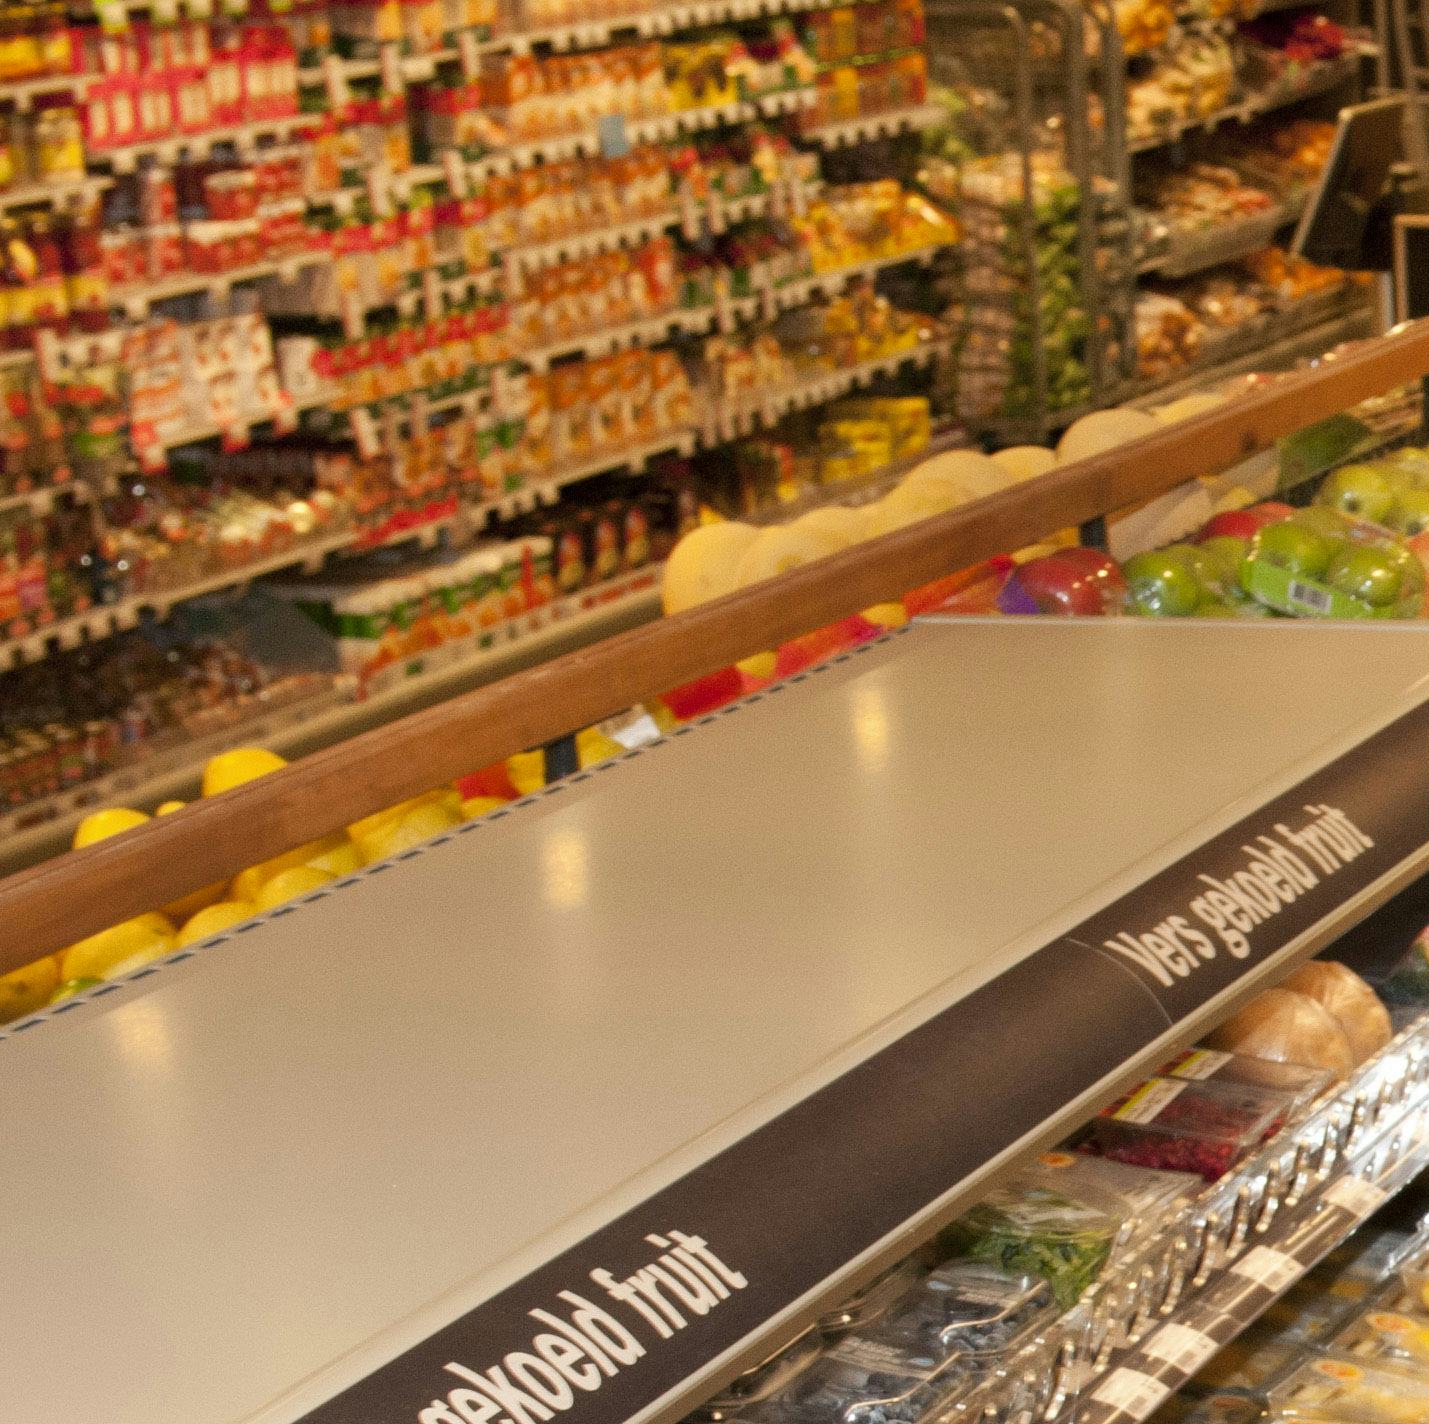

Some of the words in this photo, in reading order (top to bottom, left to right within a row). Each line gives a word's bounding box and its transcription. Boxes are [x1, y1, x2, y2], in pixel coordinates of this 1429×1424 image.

[1103, 915, 1216, 987] Vers
[1189, 835, 1319, 959] gekoeld
[1274, 804, 1374, 875] fruit
[589, 1230, 748, 1339] fruit
